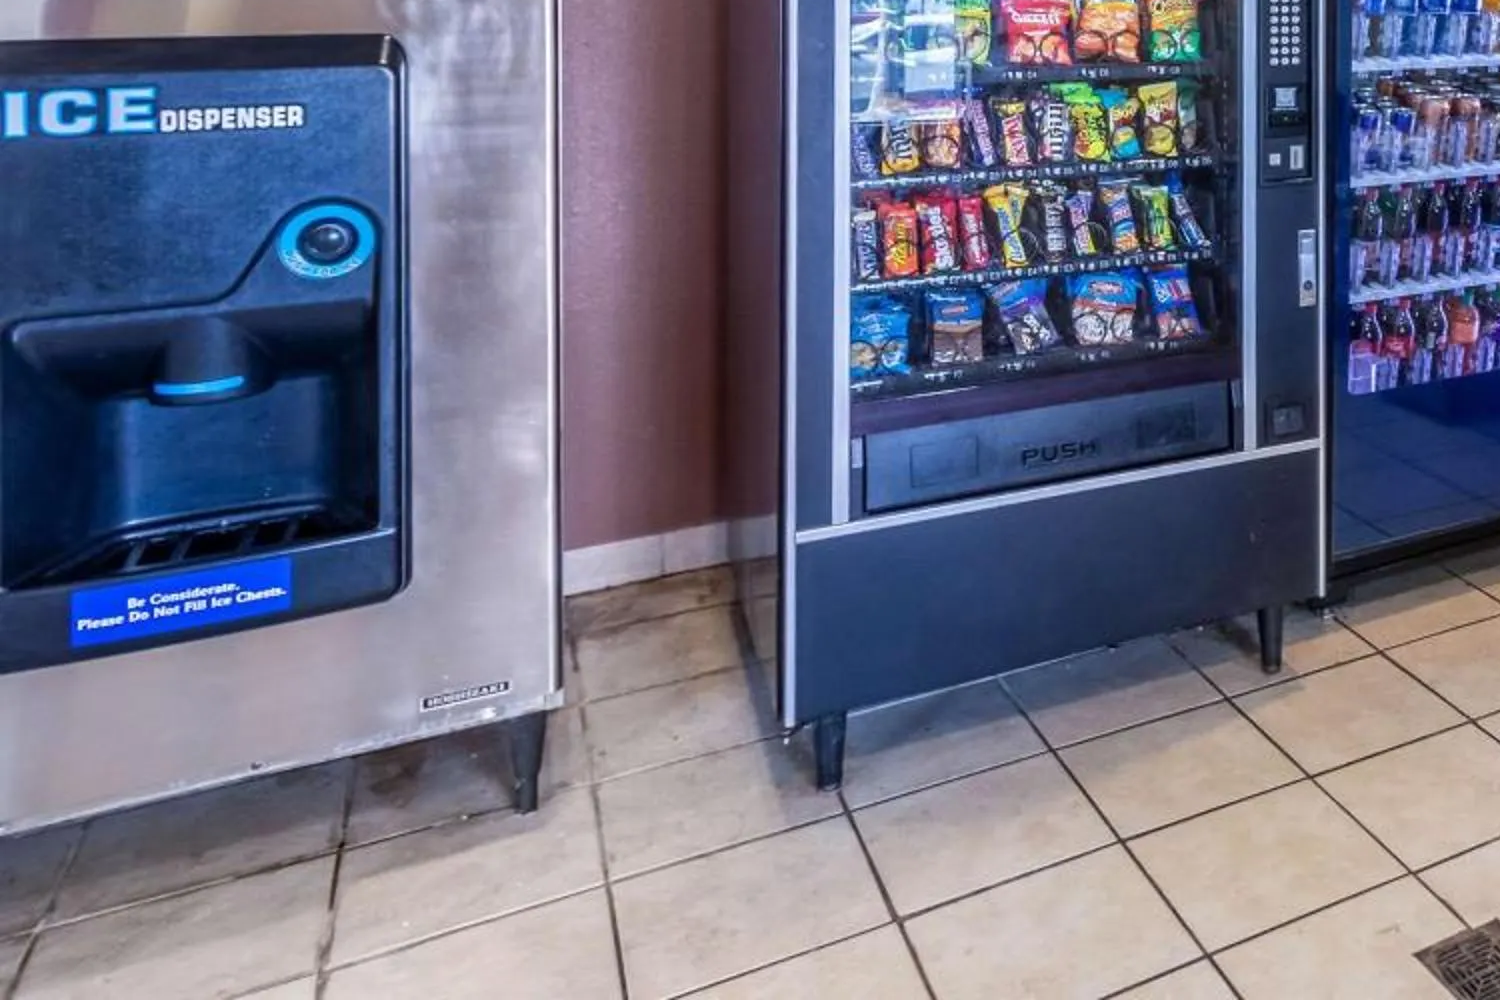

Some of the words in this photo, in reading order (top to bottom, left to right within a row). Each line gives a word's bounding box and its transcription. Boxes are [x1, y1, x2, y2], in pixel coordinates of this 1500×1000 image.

[3, 86, 157, 137] ICE
[159, 105, 304, 132] DISPENSER
[1022, 441, 1097, 467] PUSH
[77, 615, 124, 631] Please
[128, 611, 150, 623] Do
[153, 604, 180, 618] Not
[183, 599, 207, 613] Fill
[211, 596, 233, 608] Ice
[236, 586, 288, 603] Chests.
[127, 597, 146, 609] Be
[150, 582, 241, 604] Considerate.
